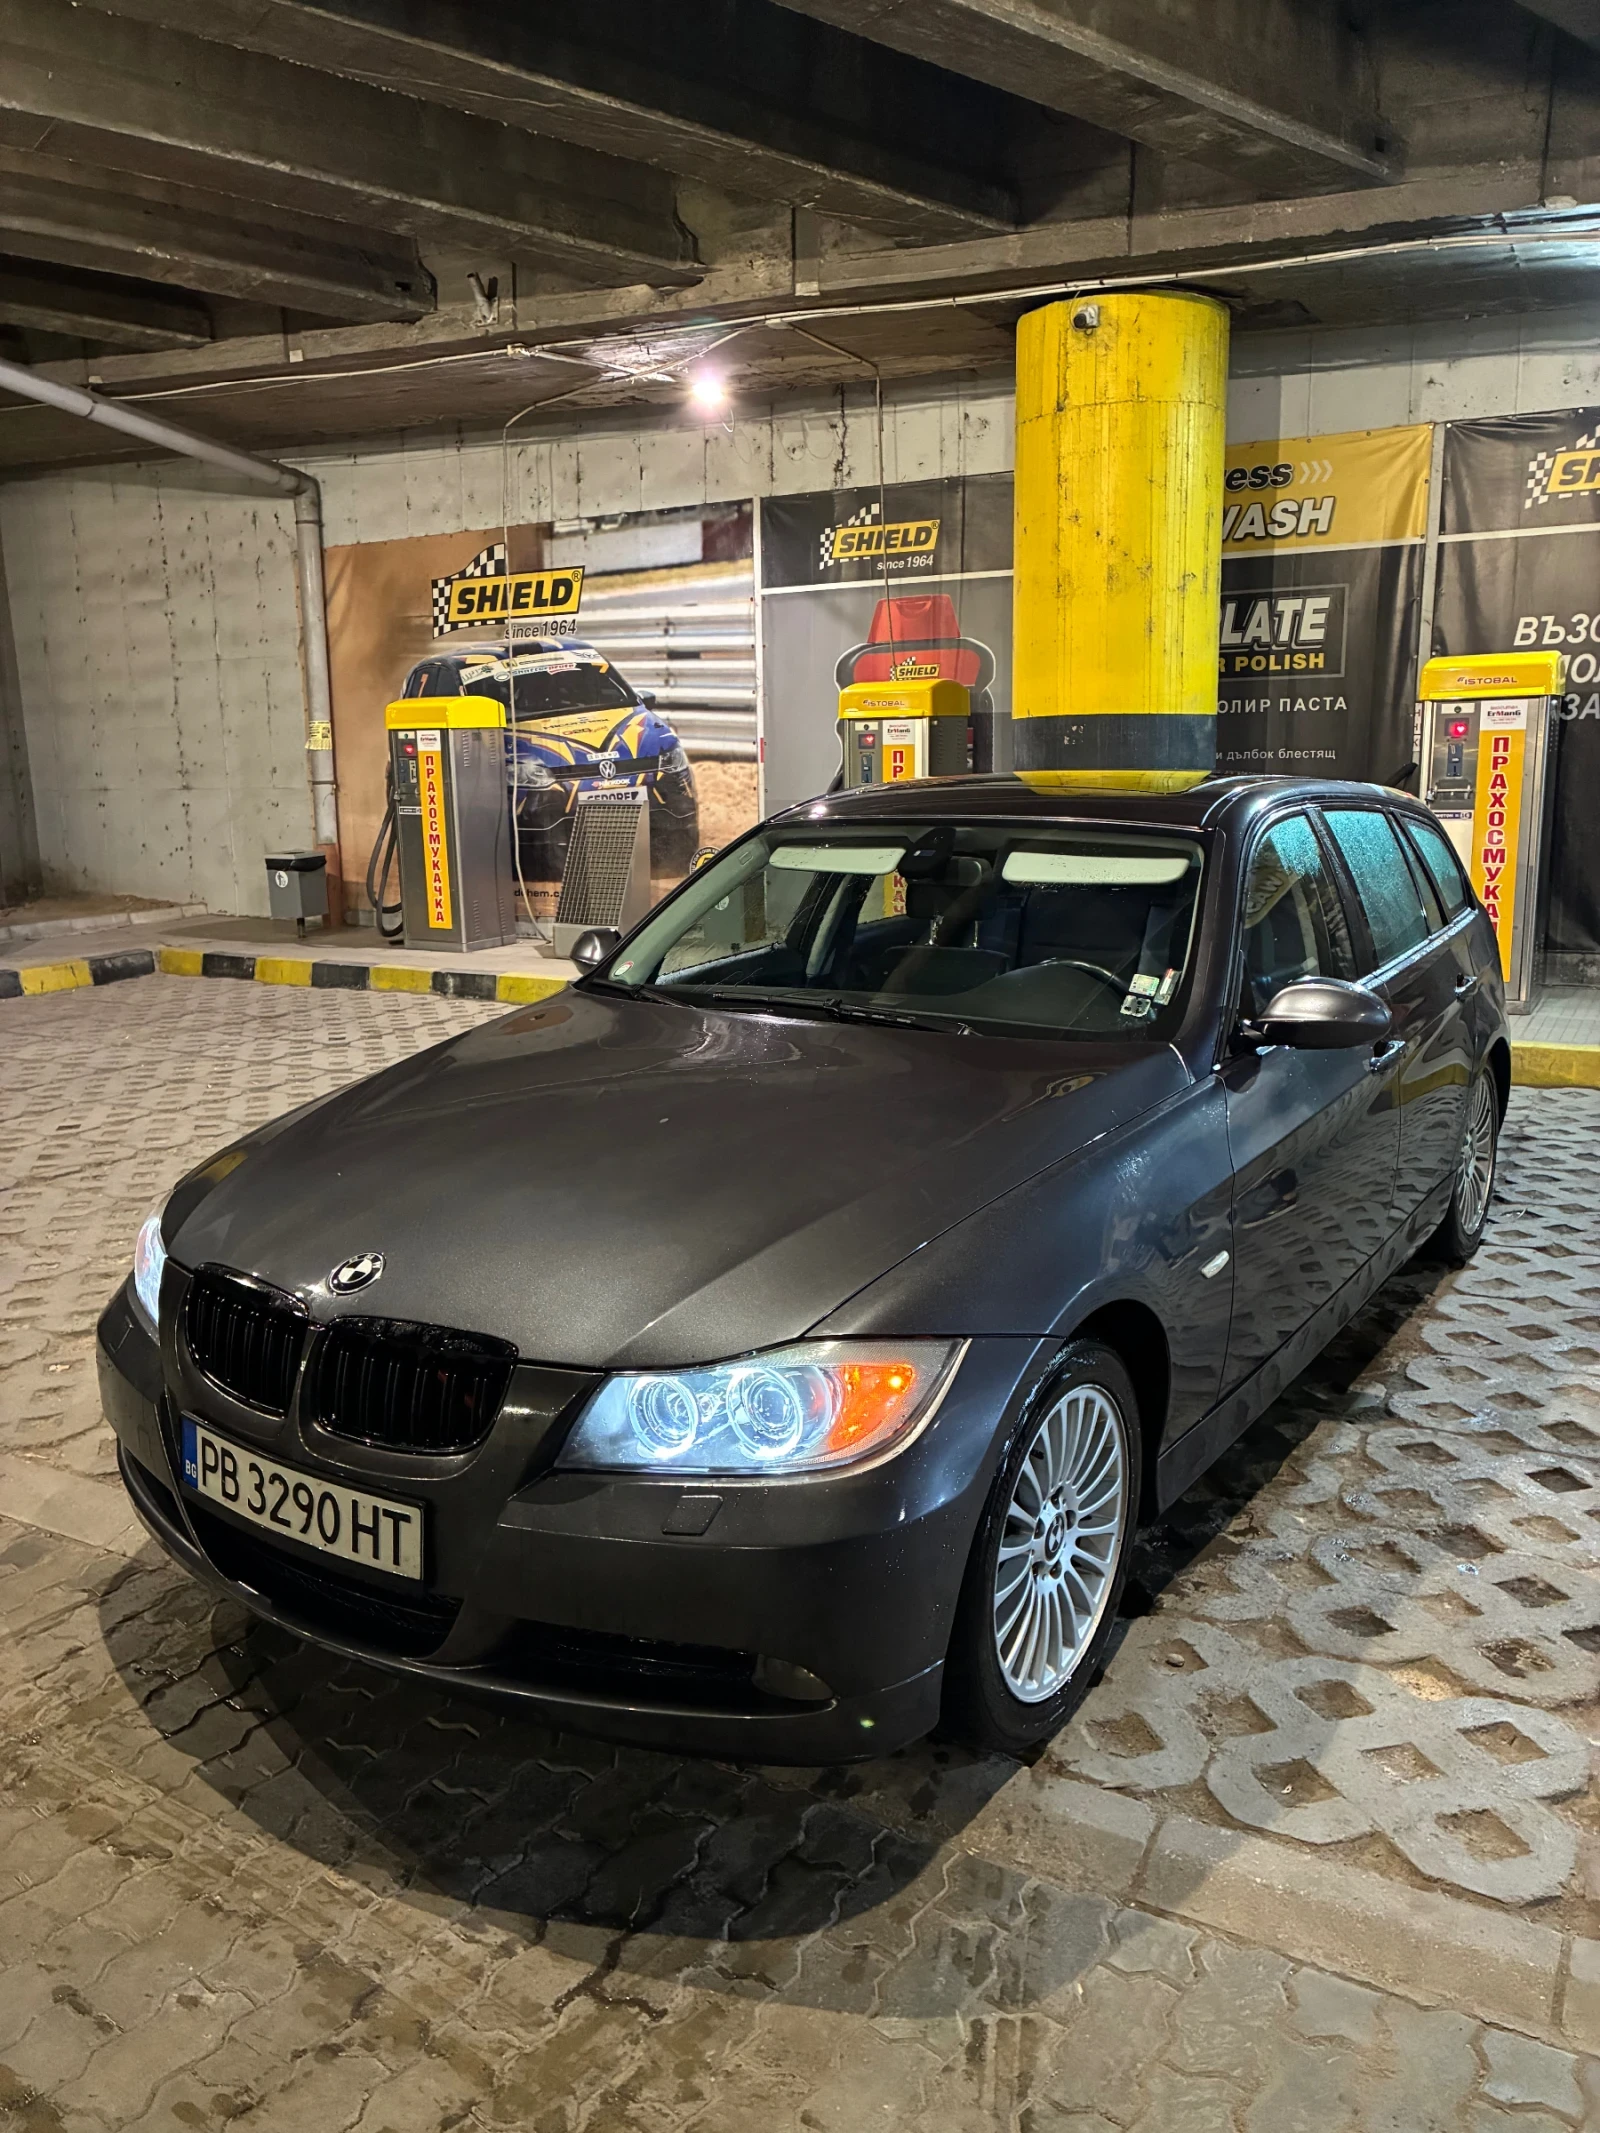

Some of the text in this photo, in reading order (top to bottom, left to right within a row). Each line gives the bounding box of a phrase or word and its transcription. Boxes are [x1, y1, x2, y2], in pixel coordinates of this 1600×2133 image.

[1224, 463, 1293, 492] ess
[906, 554, 934, 568] 1964
[541, 618, 577, 636] 1964
[1220, 596, 1331, 645] LATE
[1234, 652, 1325, 672] POLISH
[898, 666, 937, 677] SHIELD
[1464, 676, 1518, 685] ISTOBAL
[867, 699, 905, 707] ISTOBAL
[1279, 696, 1348, 712] ПАСТА
[1226, 748, 1274, 761] дълбок
[1278, 748, 1336, 760] блестящ
[425, 755, 445, 922] ПРАХОСМУКАЧКА
[185, 1458, 197, 1479] BG
